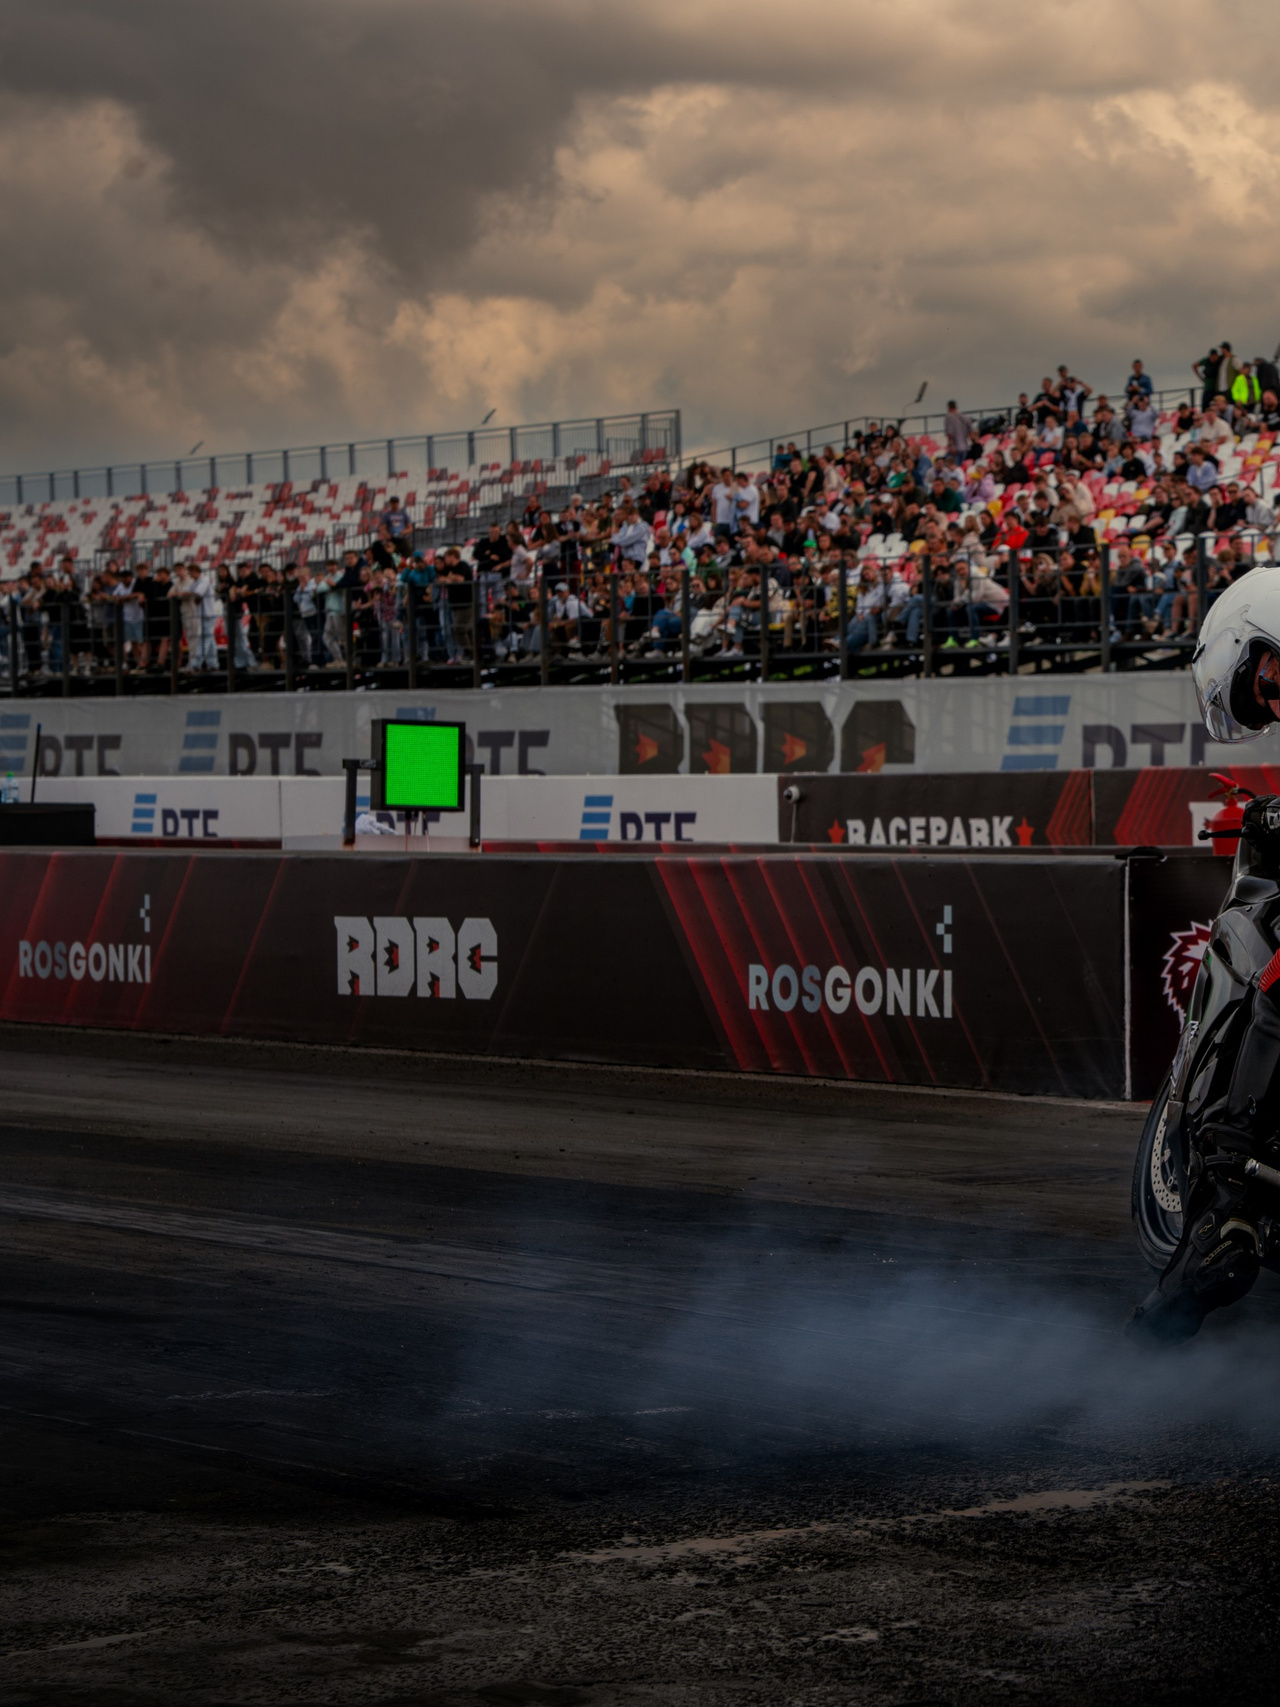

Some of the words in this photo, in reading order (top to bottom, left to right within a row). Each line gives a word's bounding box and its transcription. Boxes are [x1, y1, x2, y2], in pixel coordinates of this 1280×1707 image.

[846, 815, 1014, 847] RACEPARK
[18, 939, 151, 984] ROSGONKI
[334, 916, 498, 999] RDRC
[748, 963, 953, 1019] ROSGONKI
